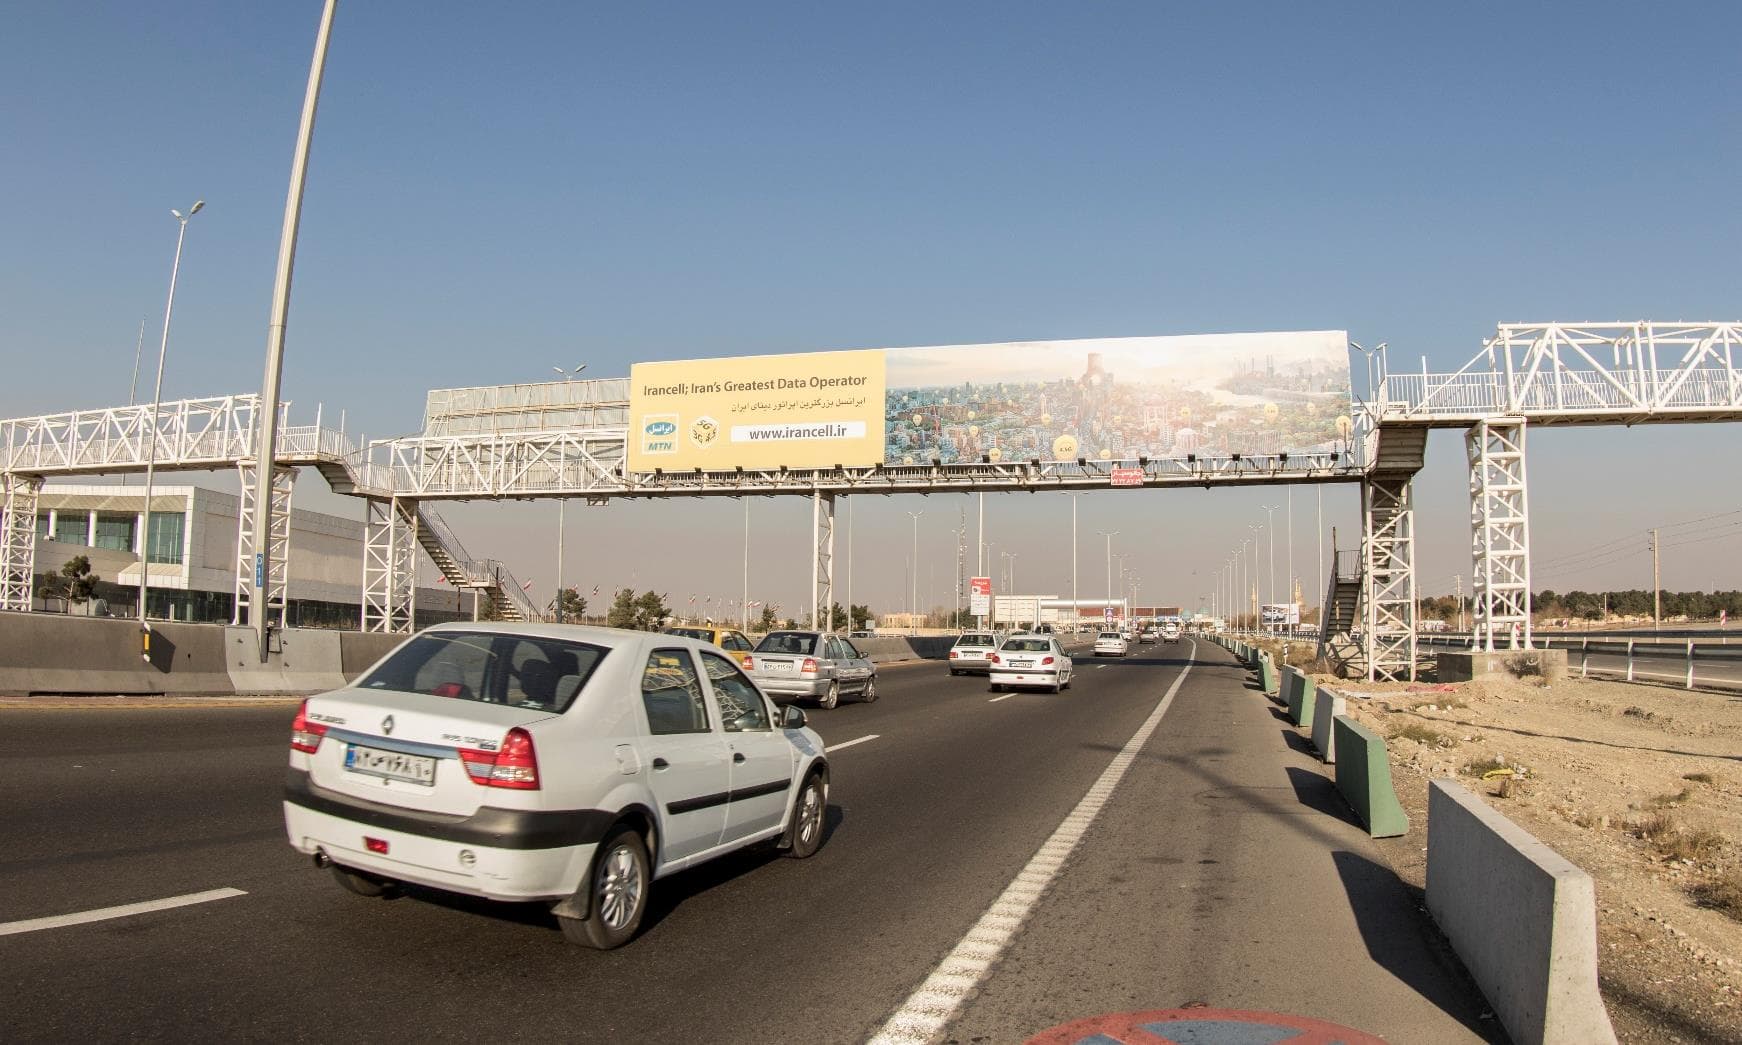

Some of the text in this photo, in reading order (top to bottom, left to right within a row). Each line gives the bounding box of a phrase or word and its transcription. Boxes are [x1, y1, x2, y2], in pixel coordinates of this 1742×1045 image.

[644, 383, 689, 396] Irancell;
[724, 380, 775, 392] Greatest
[777, 378, 807, 389] Data
[809, 376, 867, 390] Operator
[731, 402, 749, 413] ایران
[836, 396, 866, 408] ایرانسل
[648, 423, 673, 435] ایرانسل
[749, 424, 847, 440] www.irancell.ir
[648, 442, 673, 451] MTN
